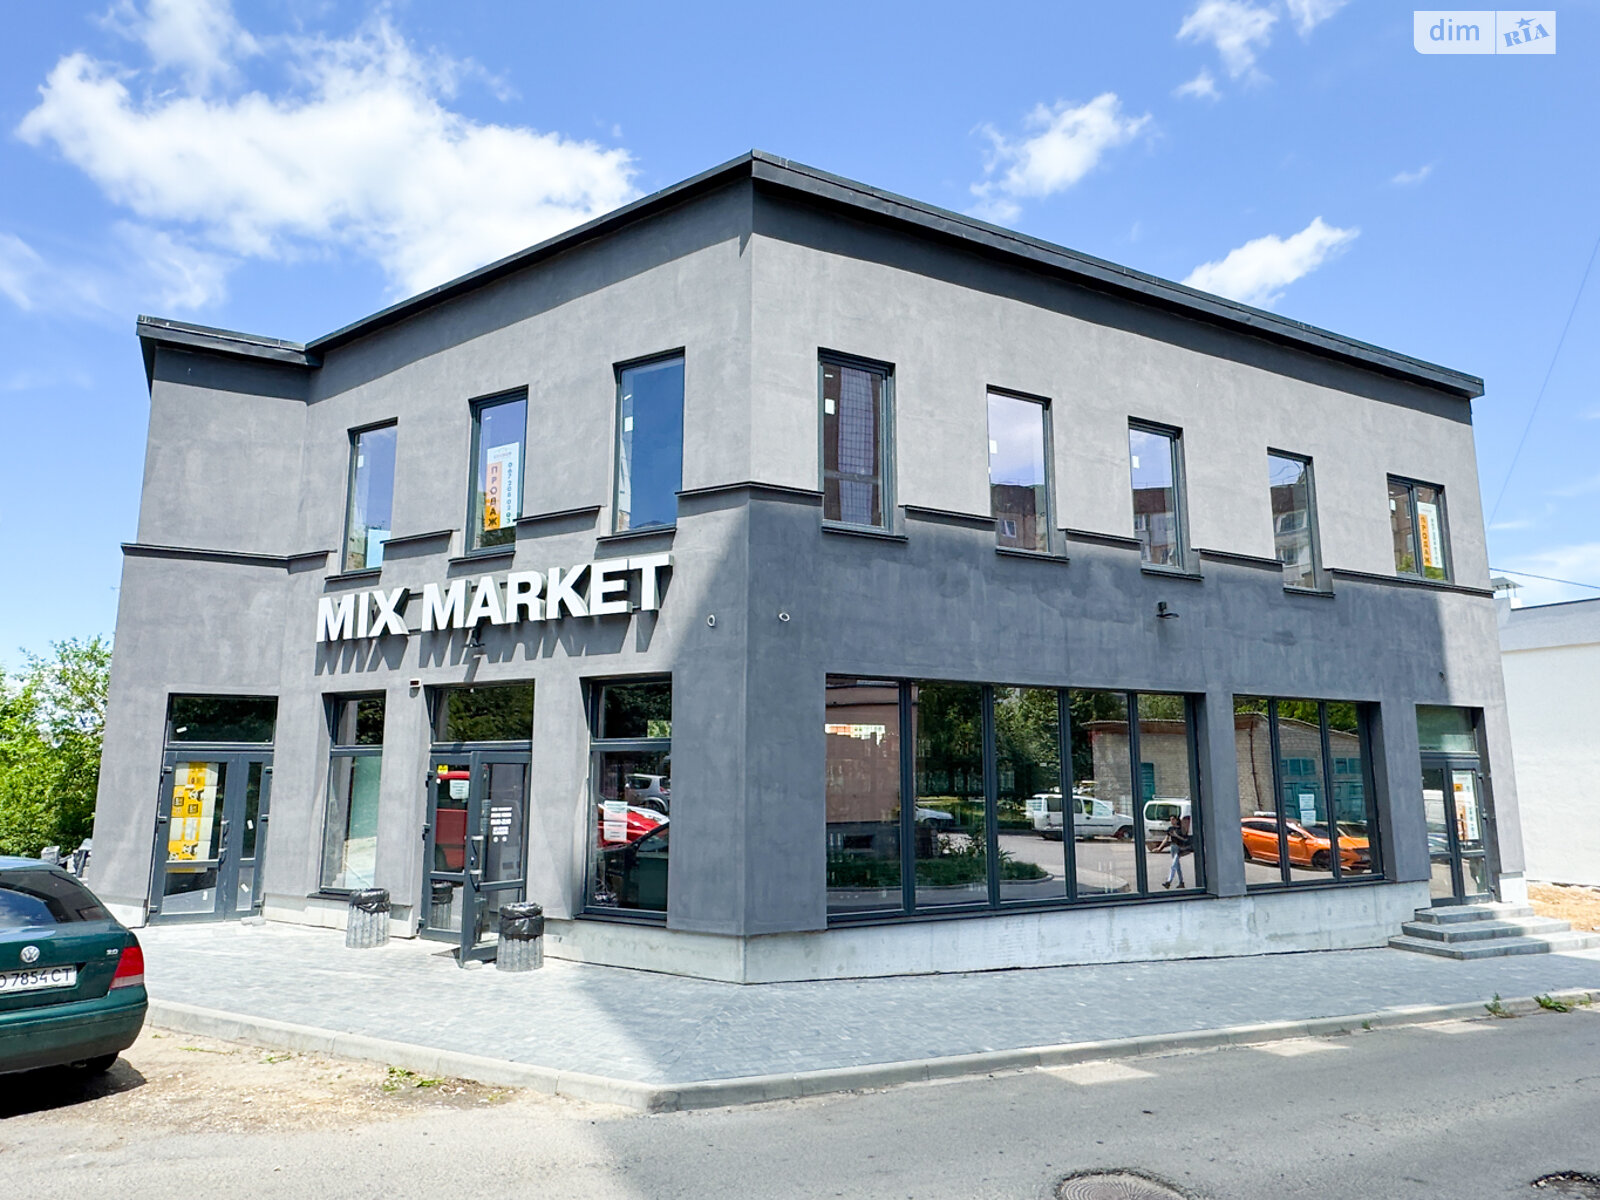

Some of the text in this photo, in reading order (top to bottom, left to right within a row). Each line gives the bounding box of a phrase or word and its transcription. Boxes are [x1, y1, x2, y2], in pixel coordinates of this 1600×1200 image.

[488, 465, 498, 526] ПРОДАЖ
[316, 554, 674, 642] MIX MARKET
